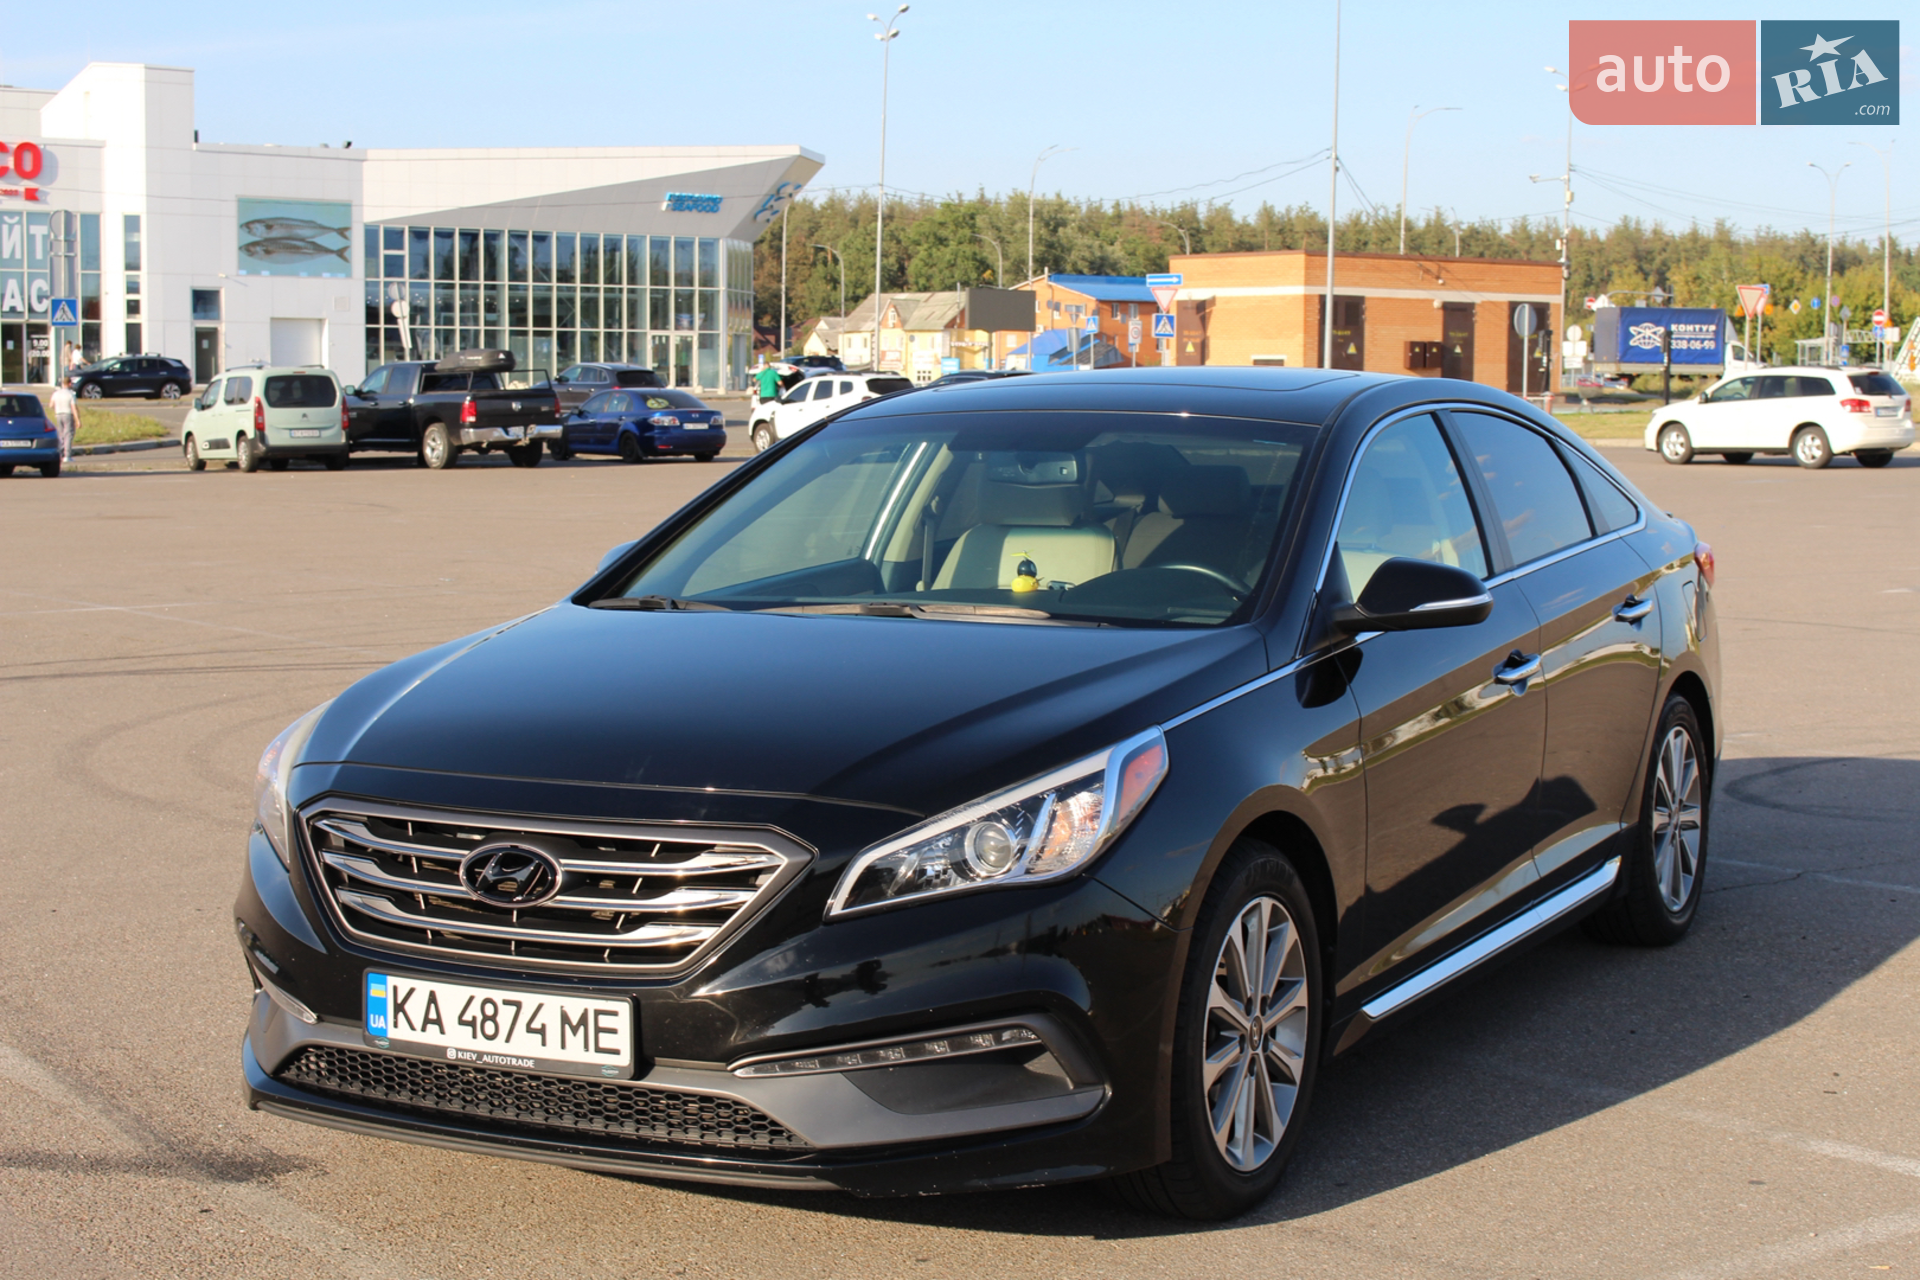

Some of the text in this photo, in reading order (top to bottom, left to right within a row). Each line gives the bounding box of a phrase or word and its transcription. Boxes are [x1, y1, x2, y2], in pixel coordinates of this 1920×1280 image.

[1671, 324, 1716, 332] КОНТУР
[1671, 340, 1716, 350] 338-06-99
[370, 984, 621, 1056] UA KA 4874 ME
